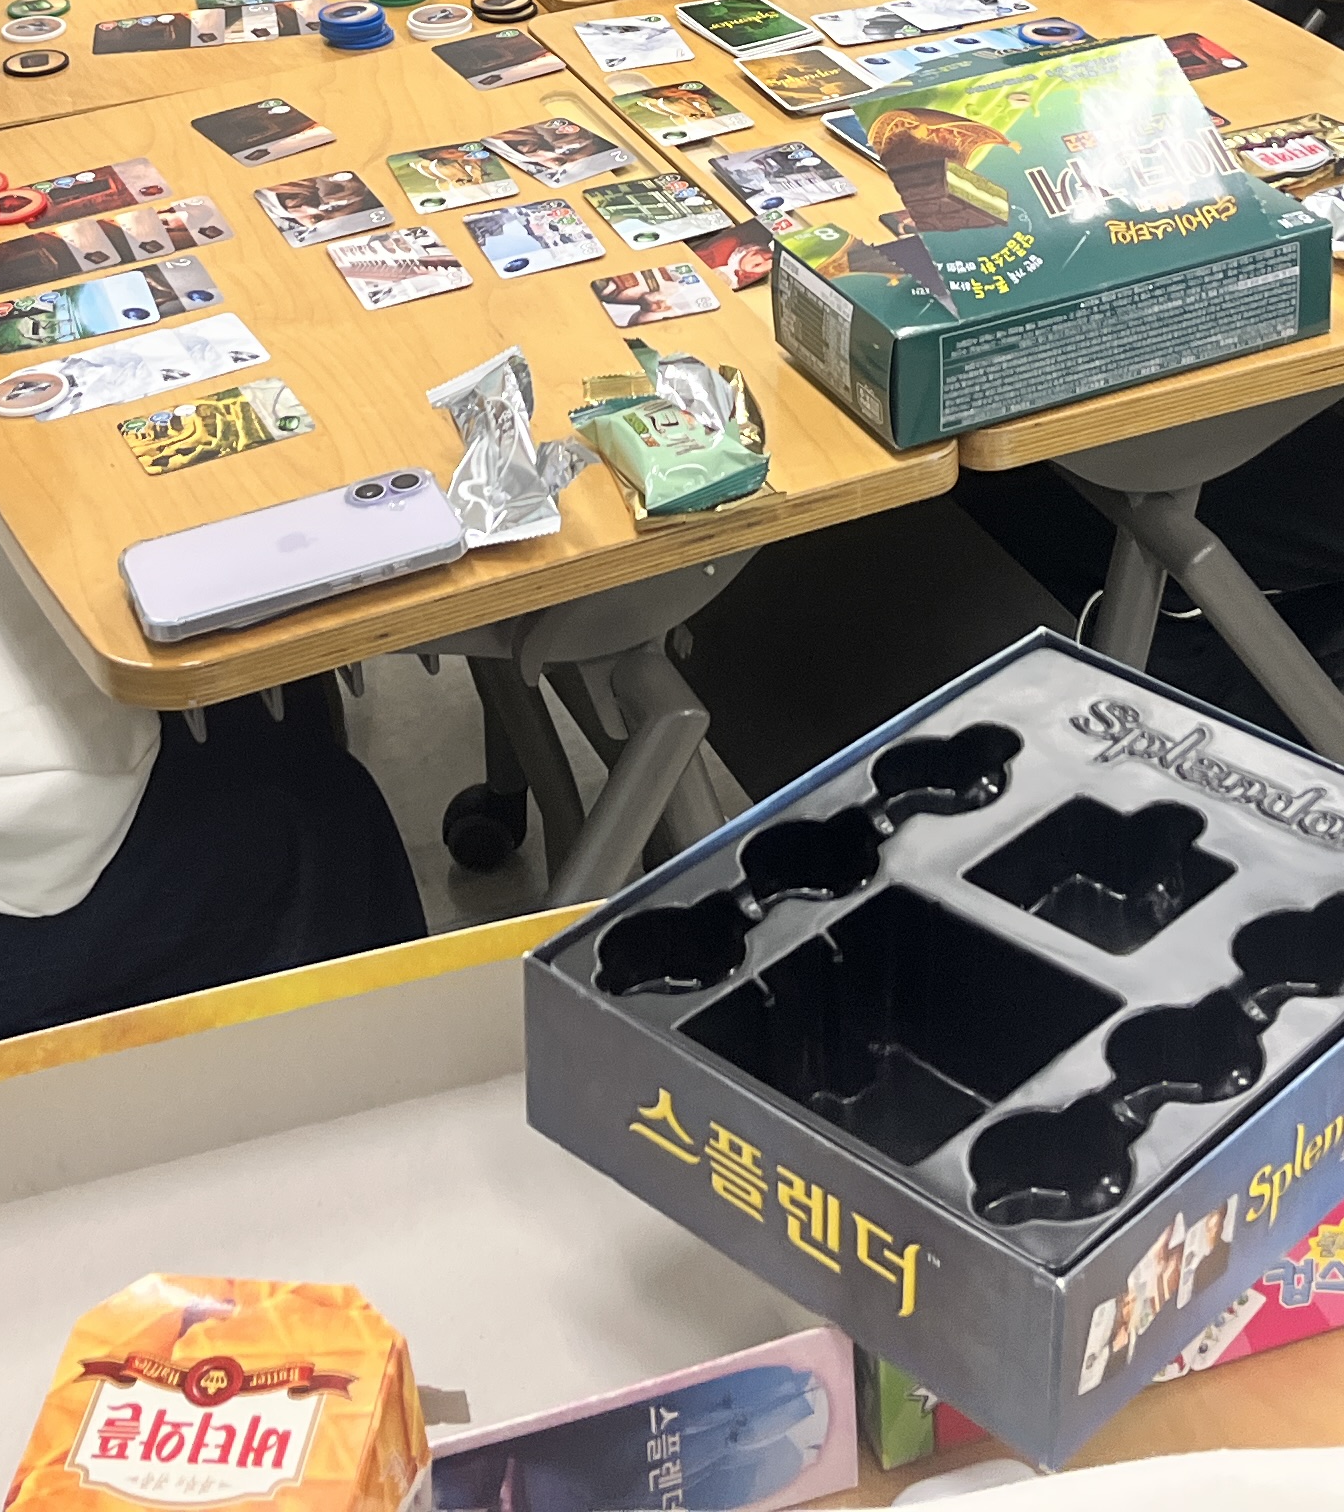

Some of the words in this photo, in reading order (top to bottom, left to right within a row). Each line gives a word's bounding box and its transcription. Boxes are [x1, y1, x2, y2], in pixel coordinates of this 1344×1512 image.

[1255, 143, 1324, 167] 버터와플
[1174, 194, 1238, 236] 두바이
[813, 227, 840, 241] 8
[1104, 217, 1175, 245] 스타일
[977, 231, 1035, 274] 달콤고소한
[1023, 254, 1044, 273] 입안
[1006, 268, 1027, 285] 가득
[628, 1088, 921, 1318] 스플렌더
[249, 1366, 301, 1389] Butter
[90, 1401, 292, 1470] 버터와플
